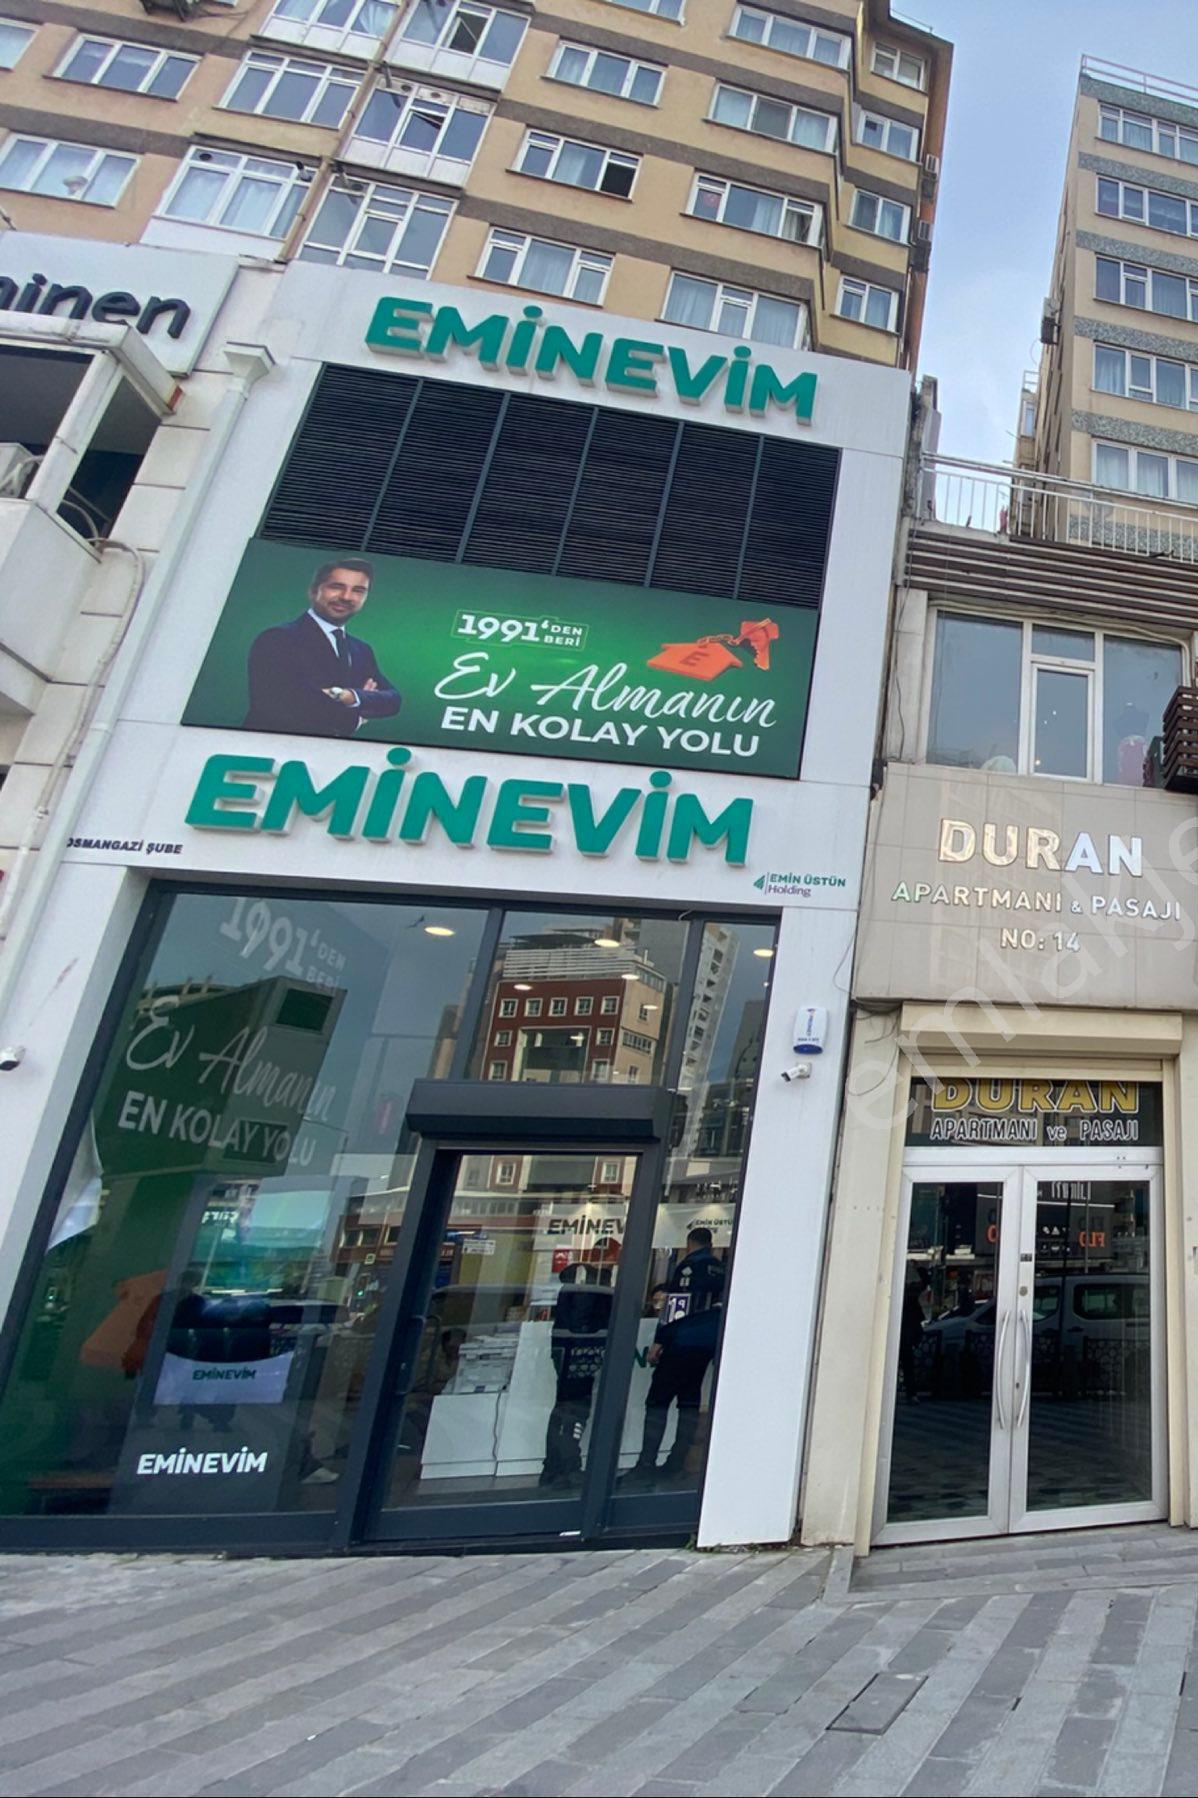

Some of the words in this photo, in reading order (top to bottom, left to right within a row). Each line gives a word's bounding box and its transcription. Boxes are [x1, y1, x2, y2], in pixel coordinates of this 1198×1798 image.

[365, 296, 817, 425] EMİNEVİM
[543, 635, 581, 648] BERİ
[434, 651, 516, 700] Ev
[530, 662, 777, 728] Almanın
[440, 706, 498, 733] EN
[510, 712, 648, 746] KOLAY
[656, 726, 760, 757] YOLU
[184, 747, 754, 866] EMİNEVİM
[146, 842, 184, 855] ŞUBE
[938, 819, 1143, 877] DURAN
[768, 884, 811, 897] Holding
[769, 872, 801, 884] EMİN
[803, 873, 846, 888] ÜSTÜN
[891, 881, 1062, 912] APARTMANI
[1070, 900, 1082, 914] &
[1091, 895, 1181, 921] PASAJI
[1000, 928, 1045, 950] NO:
[1052, 931, 1081, 952] 14
[126, 995, 195, 1070] Ev
[931, 1078, 1139, 1113] DURAN
[118, 1090, 168, 1134] EN
[169, 1103, 258, 1154] KOLAY
[930, 1117, 1038, 1140] APARTMANI
[1046, 1125, 1068, 1141] ve
[1079, 1120, 1139, 1141] PASAJI
[547, 1214, 626, 1235] EMİNEV
[192, 1368, 257, 1380] EMİNEVİM
[137, 1446, 268, 1475] EMİNEVİM
